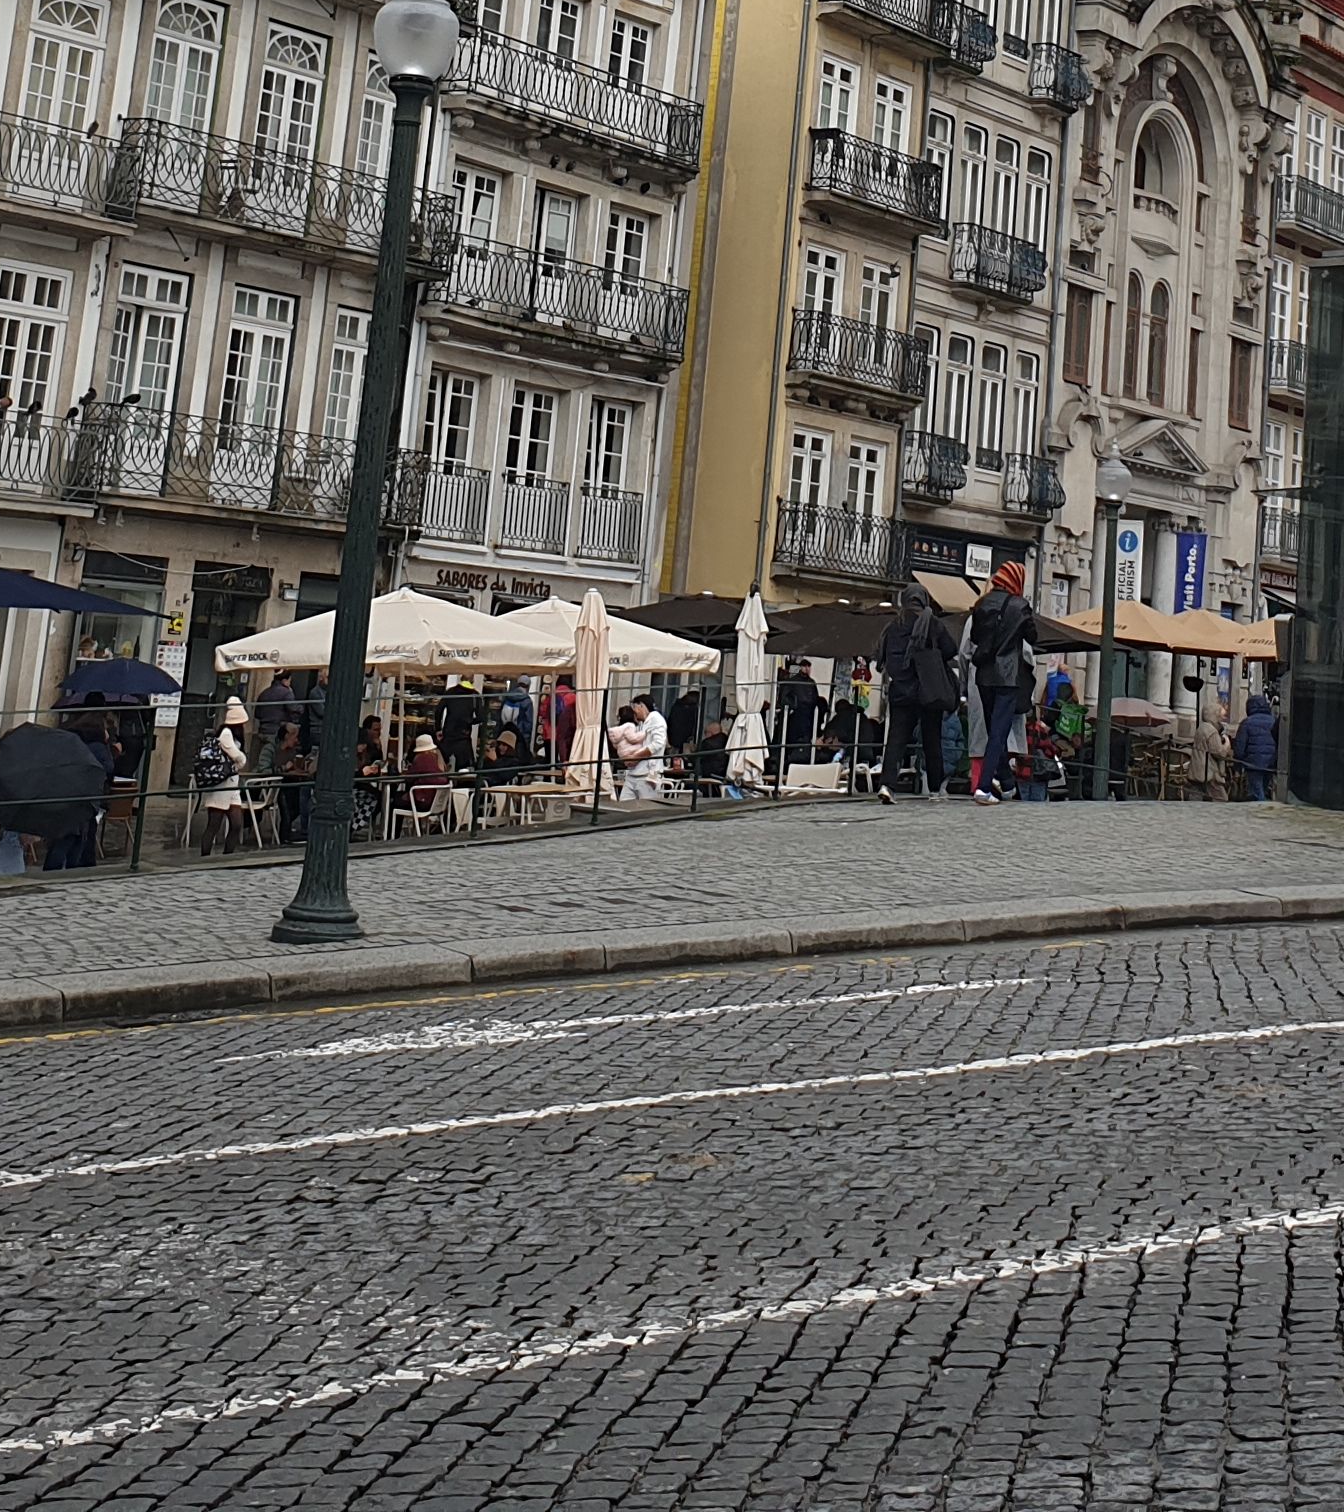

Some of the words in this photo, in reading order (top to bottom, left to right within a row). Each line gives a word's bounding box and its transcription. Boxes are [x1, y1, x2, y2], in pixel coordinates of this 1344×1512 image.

[436, 568, 488, 591] SABORES
[511, 577, 552, 598] Invicta
[1117, 559, 1128, 601] FFICIAL
[1126, 560, 1136, 602] OURISM
